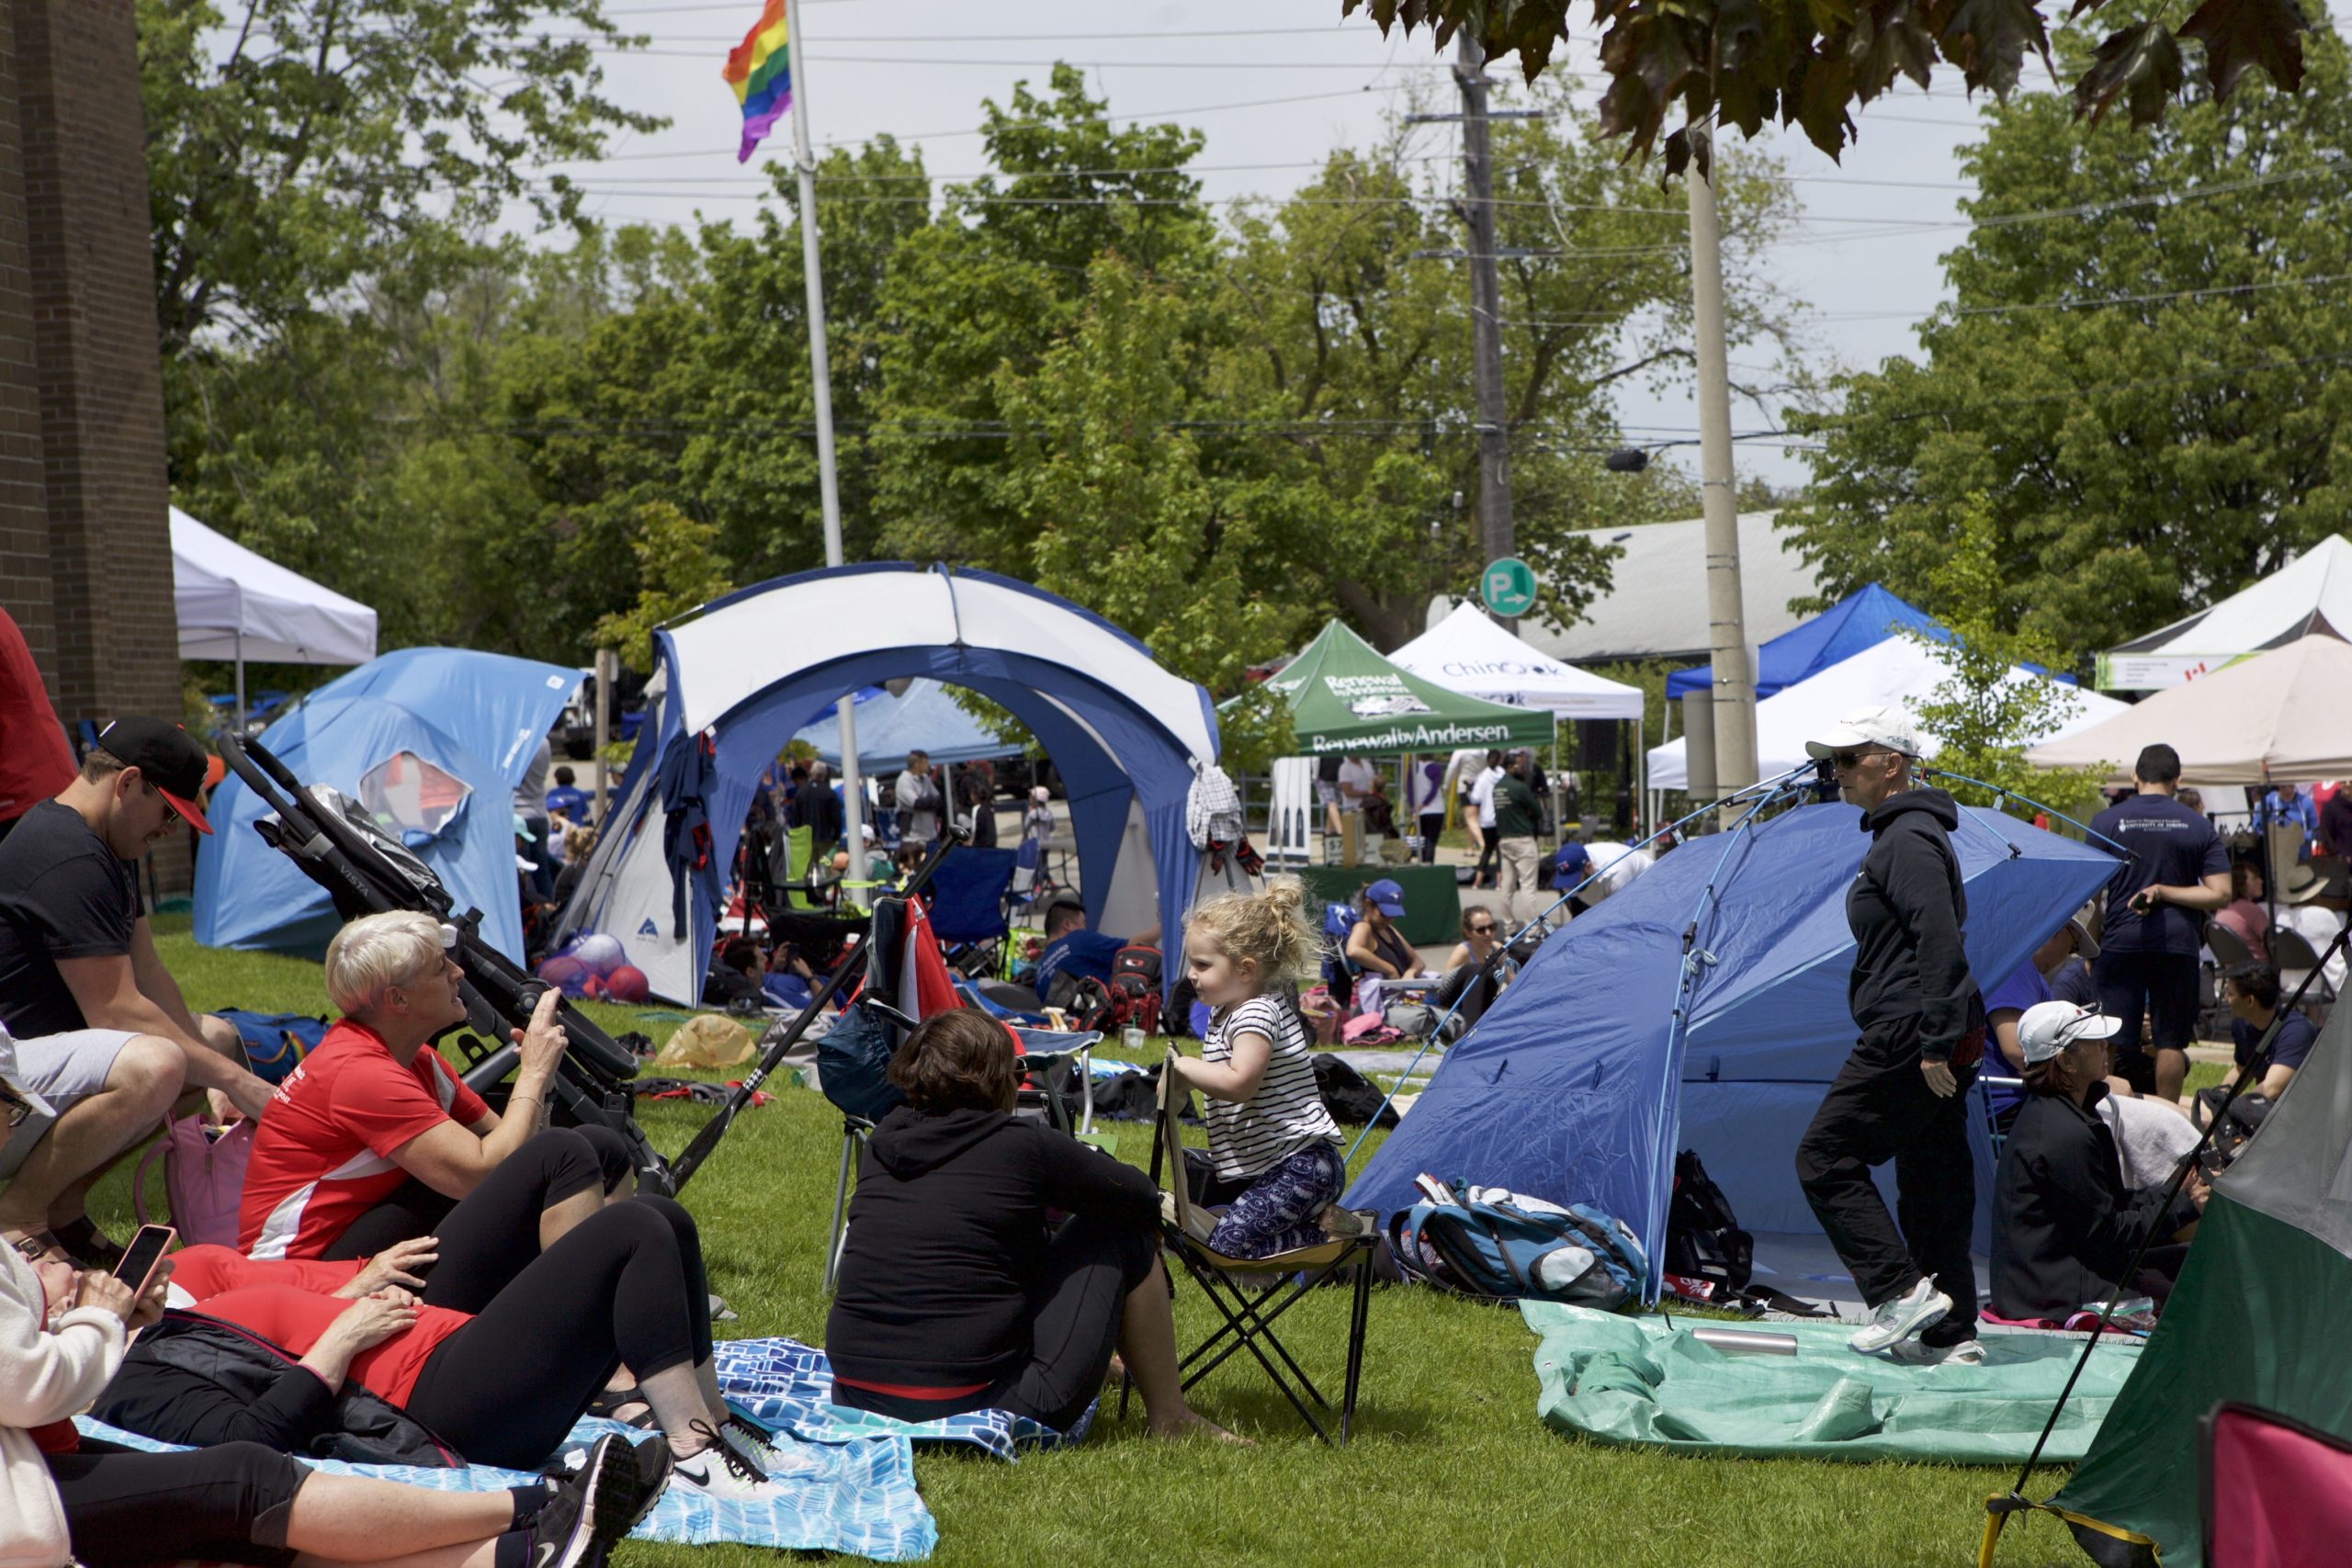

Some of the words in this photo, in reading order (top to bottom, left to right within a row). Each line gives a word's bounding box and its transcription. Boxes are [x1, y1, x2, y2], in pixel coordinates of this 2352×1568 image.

[1490, 573, 1511, 603] P
[1324, 673, 1403, 691] Renewal
[341, 864, 368, 897] VISTA
